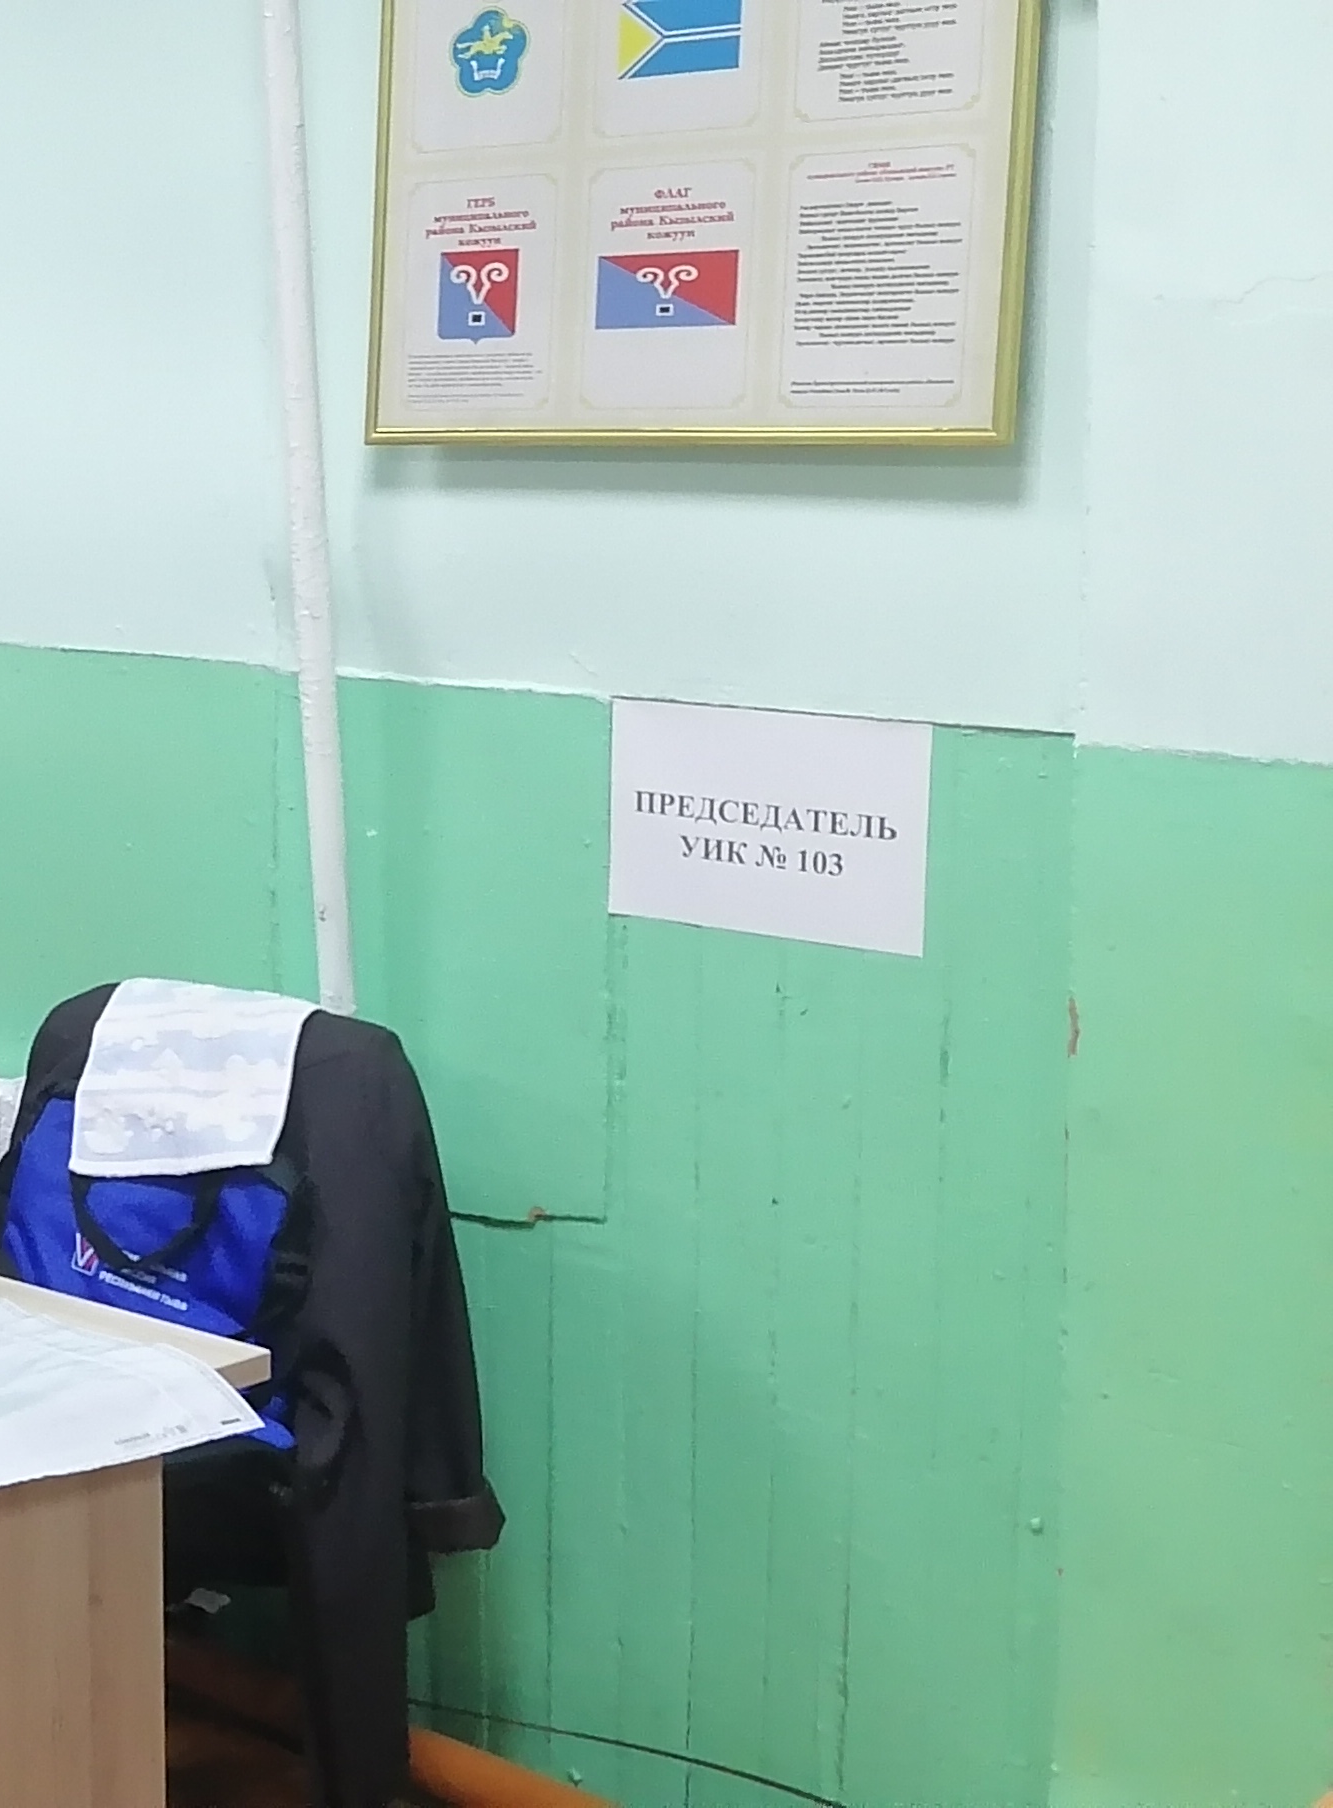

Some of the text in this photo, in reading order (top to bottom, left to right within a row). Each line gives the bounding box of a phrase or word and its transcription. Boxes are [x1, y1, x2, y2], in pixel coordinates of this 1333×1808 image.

[634, 790, 899, 841] ПРЕДСЕДАТЕЛЬ
[679, 834, 844, 877] УИК № 103
